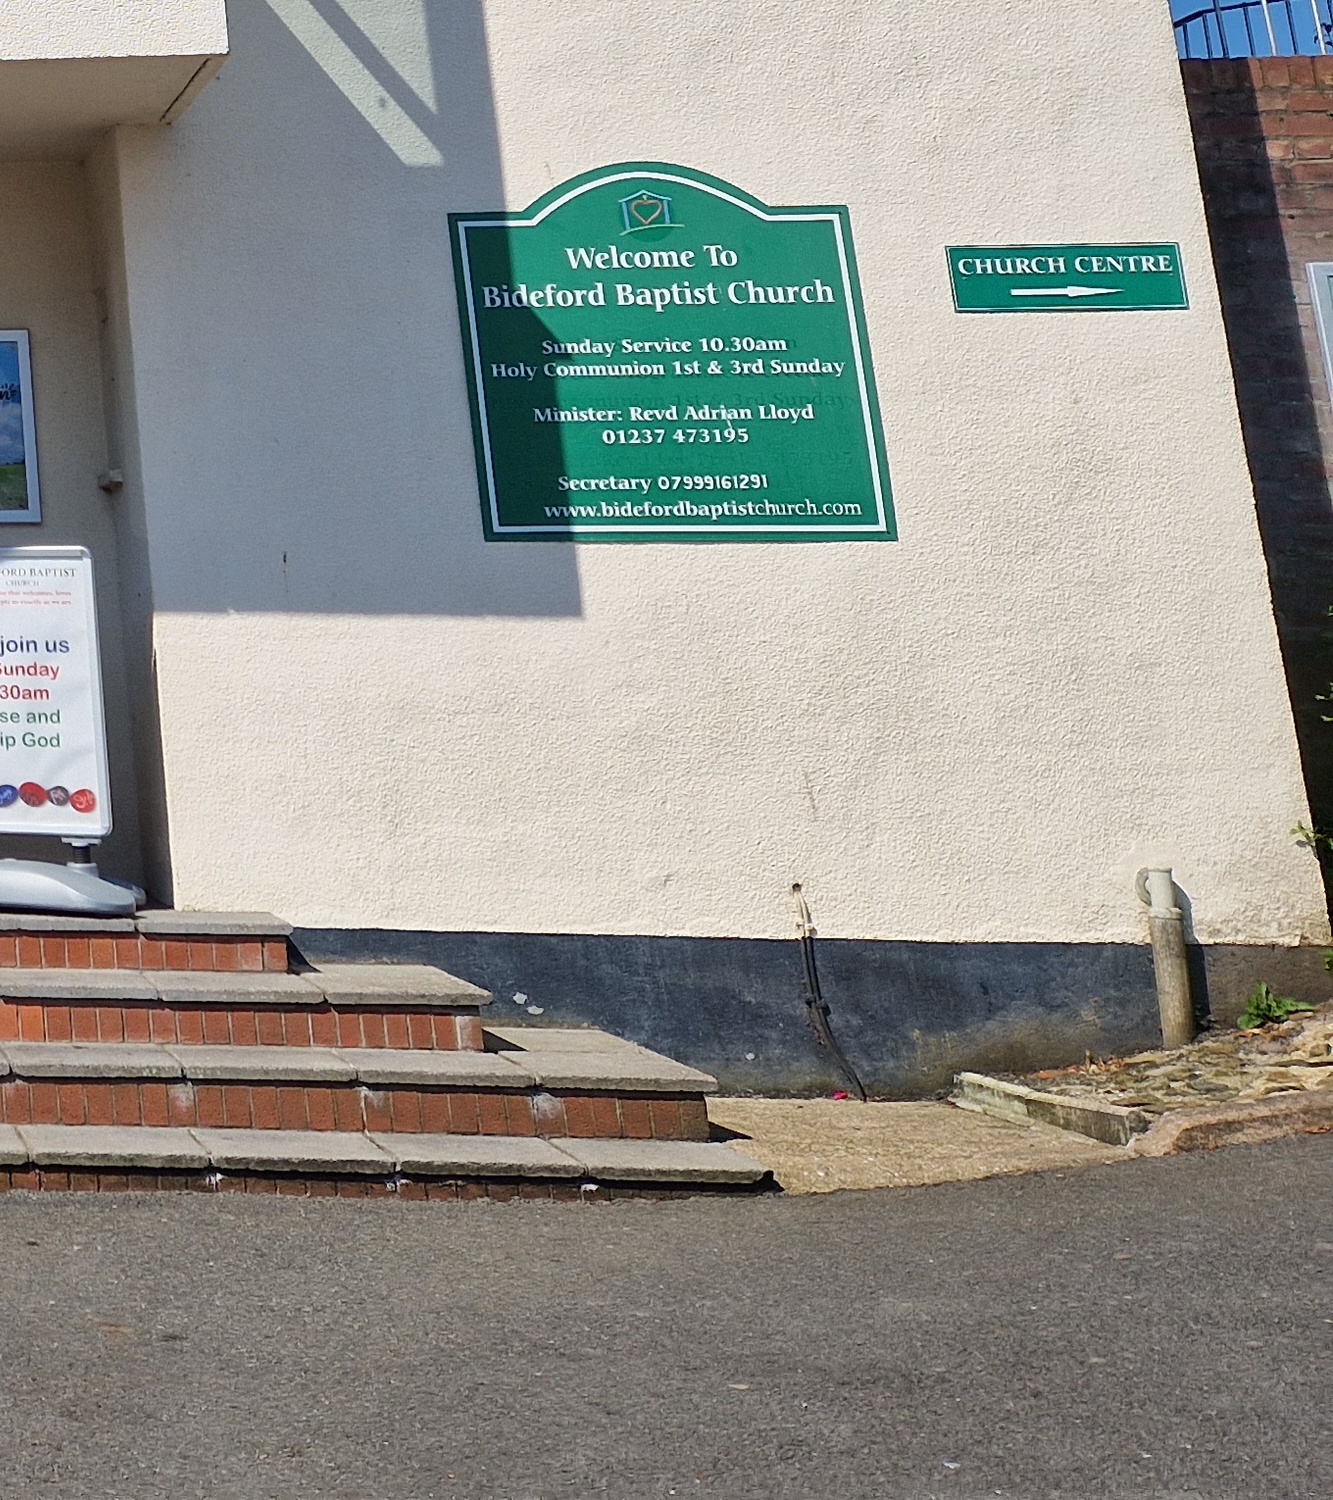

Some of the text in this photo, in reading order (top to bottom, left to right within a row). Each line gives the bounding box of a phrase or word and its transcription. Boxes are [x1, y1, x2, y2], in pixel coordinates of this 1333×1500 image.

[565, 244, 739, 271] Welcome To
[957, 254, 1174, 277] CHURCH CENTRE
[482, 279, 835, 314] Bideford Baptist Church
[541, 335, 788, 359] Sunday Service 10.30am
[490, 356, 845, 382] Holy Communion 1st & 3rd Sunday
[532, 402, 815, 425] Minister: Revd Adrian Lloyd
[601, 426, 750, 446] 01237 473195
[557, 474, 769, 495] Secretary 07999161291
[544, 498, 863, 521] www.bidefordbaptistchurch.com
[29, 568, 76, 577] BAPTIST
[0, 634, 38, 657] join
[44, 638, 70, 654] us
[25, 708, 61, 725] and
[22, 731, 61, 749] God
